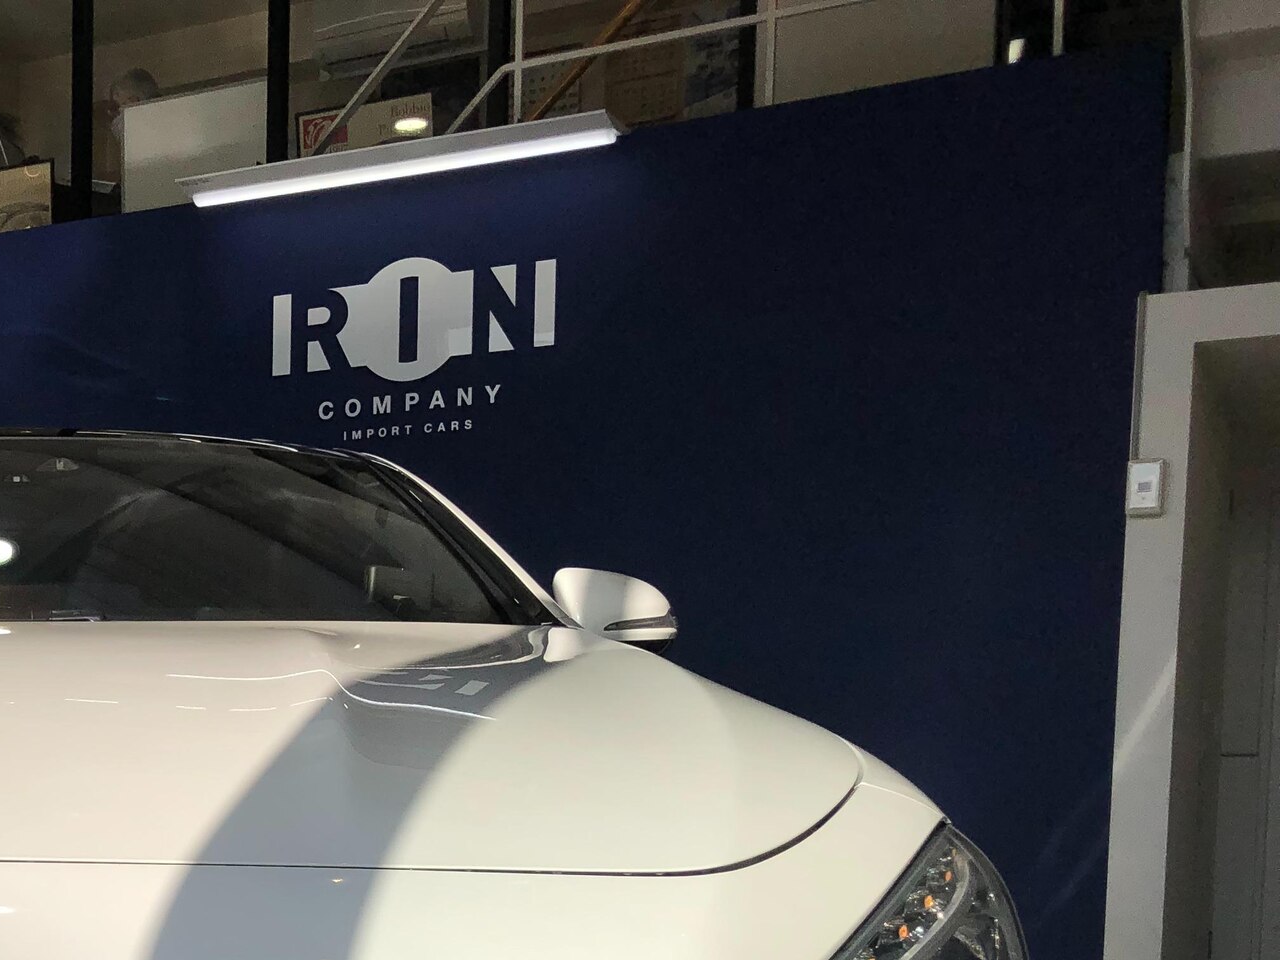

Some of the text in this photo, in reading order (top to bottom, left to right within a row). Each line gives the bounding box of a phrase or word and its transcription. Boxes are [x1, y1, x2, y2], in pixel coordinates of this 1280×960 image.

[272, 257, 557, 382] RIN
[318, 384, 501, 420] COMPANY
[343, 419, 473, 441] IMPORT CARS
